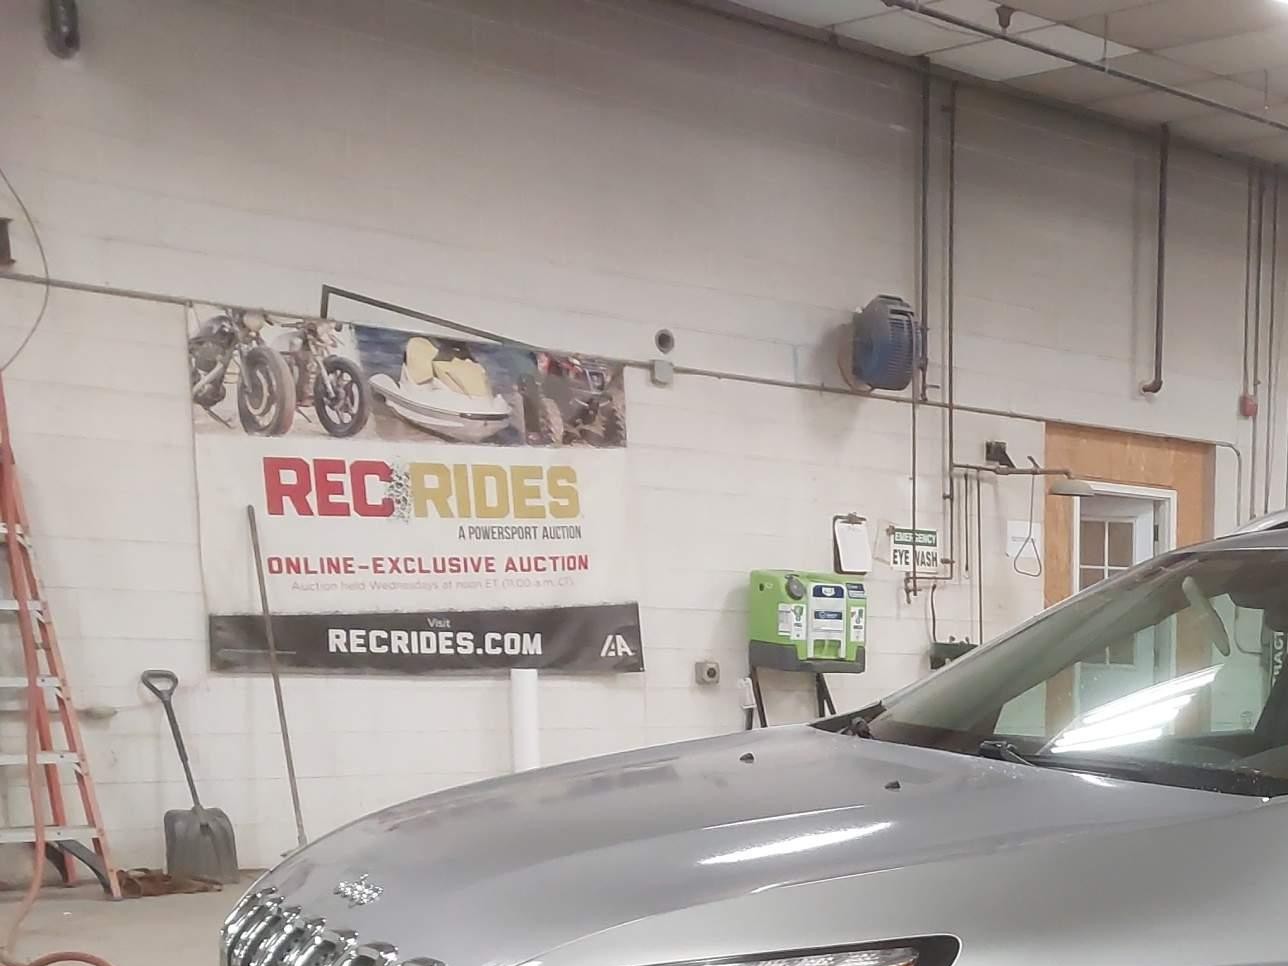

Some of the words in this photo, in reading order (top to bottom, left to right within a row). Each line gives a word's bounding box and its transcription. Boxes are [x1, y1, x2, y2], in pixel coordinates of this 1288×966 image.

[263, 456, 396, 518] REC
[409, 461, 582, 519] RIDES
[458, 526, 466, 540] A
[468, 526, 538, 541] POWERSPORT
[542, 525, 582, 540] AUCTION
[267, 555, 496, 575] ONLINE-EXCLUSIVE
[504, 554, 589, 573] AUCTION
[893, 549, 909, 565] EYE
[427, 617, 451, 628] Visit
[327, 628, 543, 656] RECRIDES.COM
